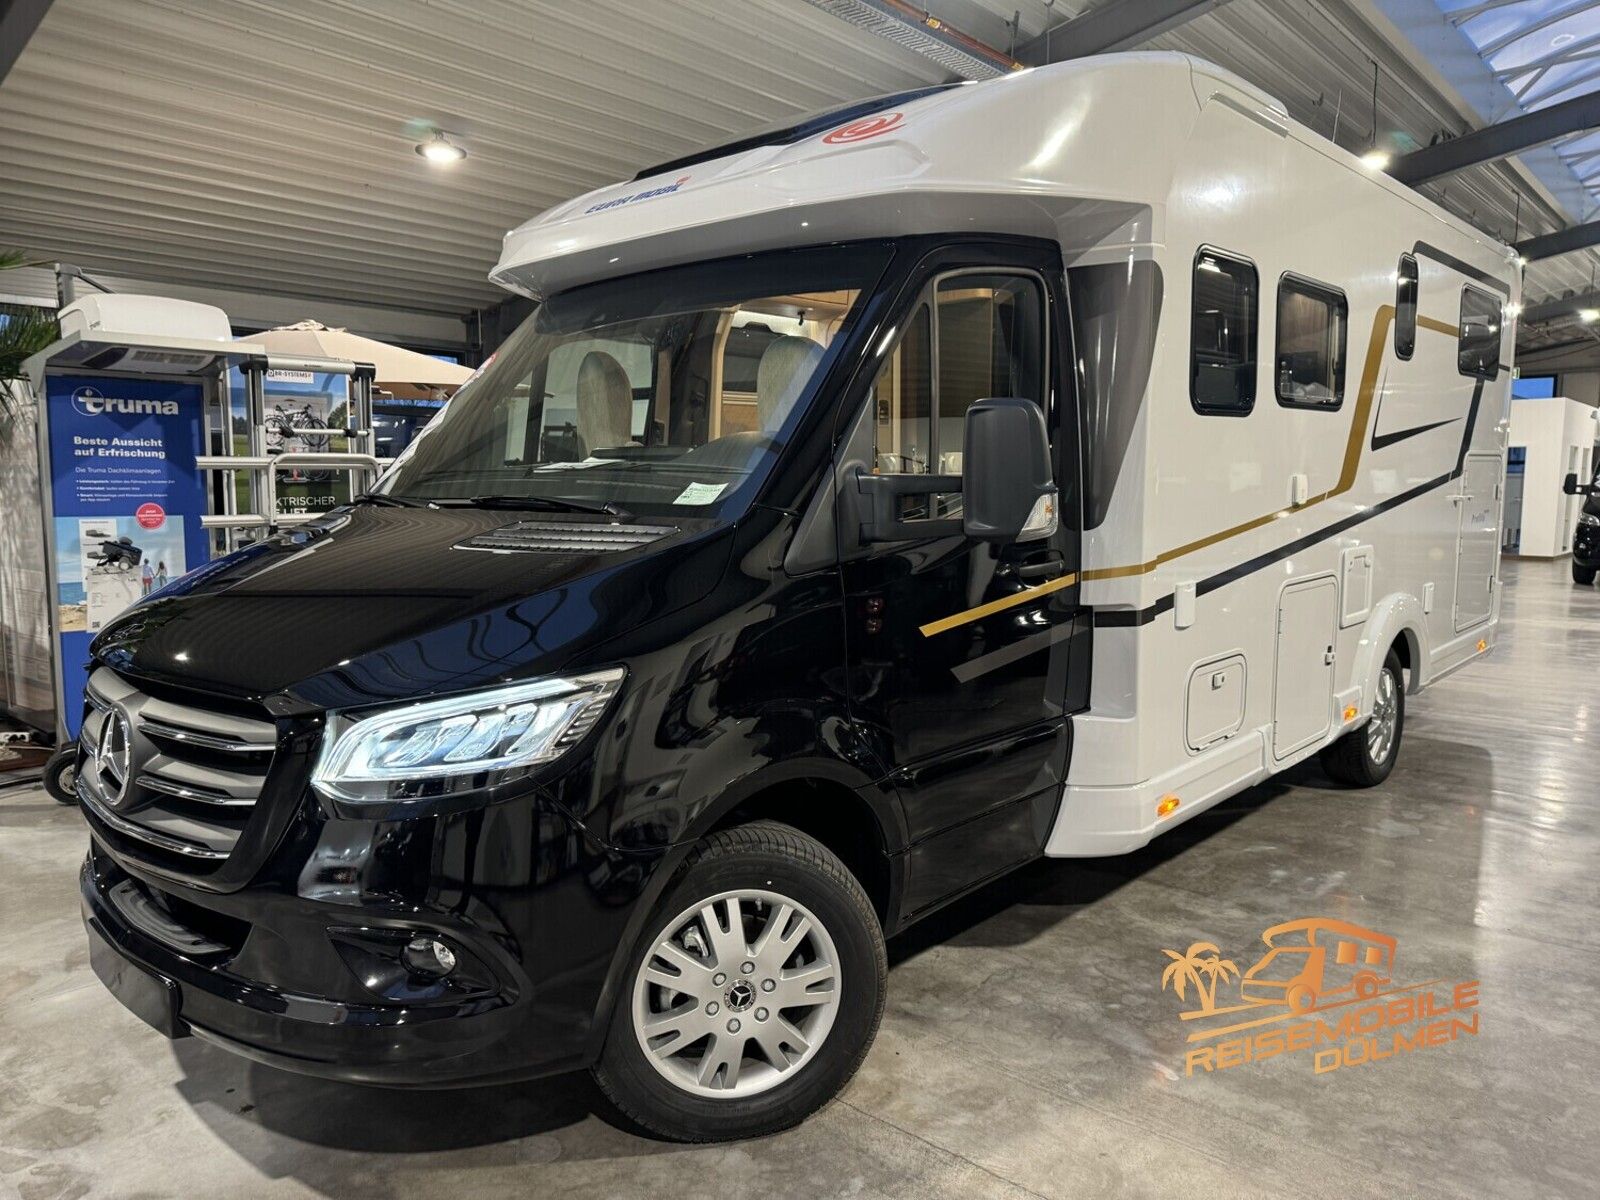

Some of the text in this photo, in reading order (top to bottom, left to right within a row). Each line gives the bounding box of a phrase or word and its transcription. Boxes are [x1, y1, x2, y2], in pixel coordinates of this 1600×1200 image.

[77, 388, 179, 415] truma
[73, 435, 163, 447] Beste Aussicht
[74, 448, 166, 459] auf Erfrischung
[275, 496, 336, 507] KTRISCHER
